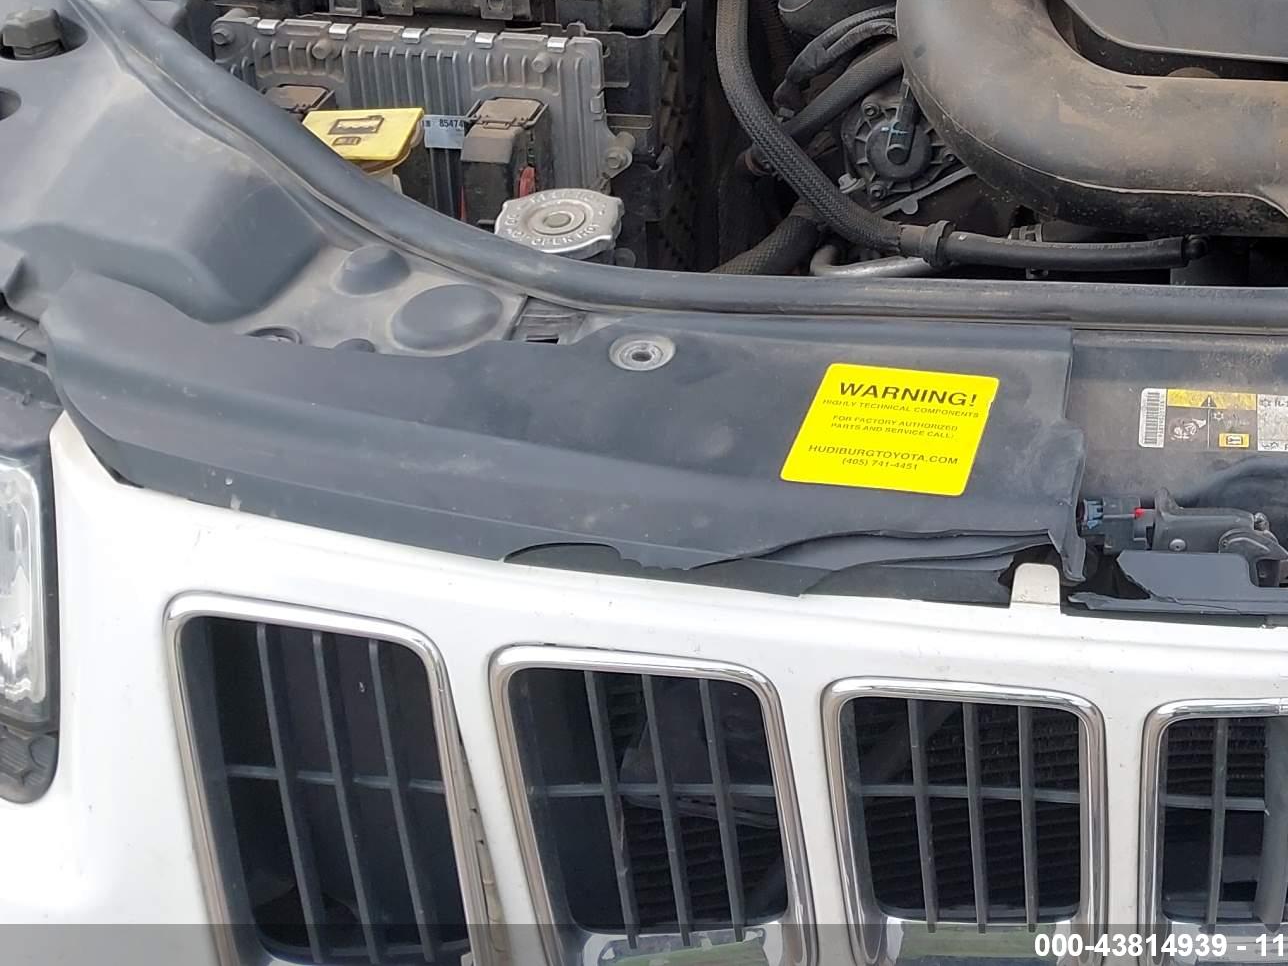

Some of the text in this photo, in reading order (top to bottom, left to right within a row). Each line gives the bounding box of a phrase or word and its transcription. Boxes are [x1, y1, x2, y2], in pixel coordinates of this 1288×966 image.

[840, 381, 977, 407] WARNING!
[822, 398, 980, 419] HIGHLY TECHNICAL COMPONENTS
[831, 422, 862, 431] PARTS
[862, 425, 883, 433] AND
[884, 426, 926, 437] SERVICE
[832, 414, 959, 432] FOR FACTORY AUTHORIZED
[808, 444, 959, 465] HUDIBURGTOYOTA.COM
[841, 457, 918, 471] (405) 741-4451
